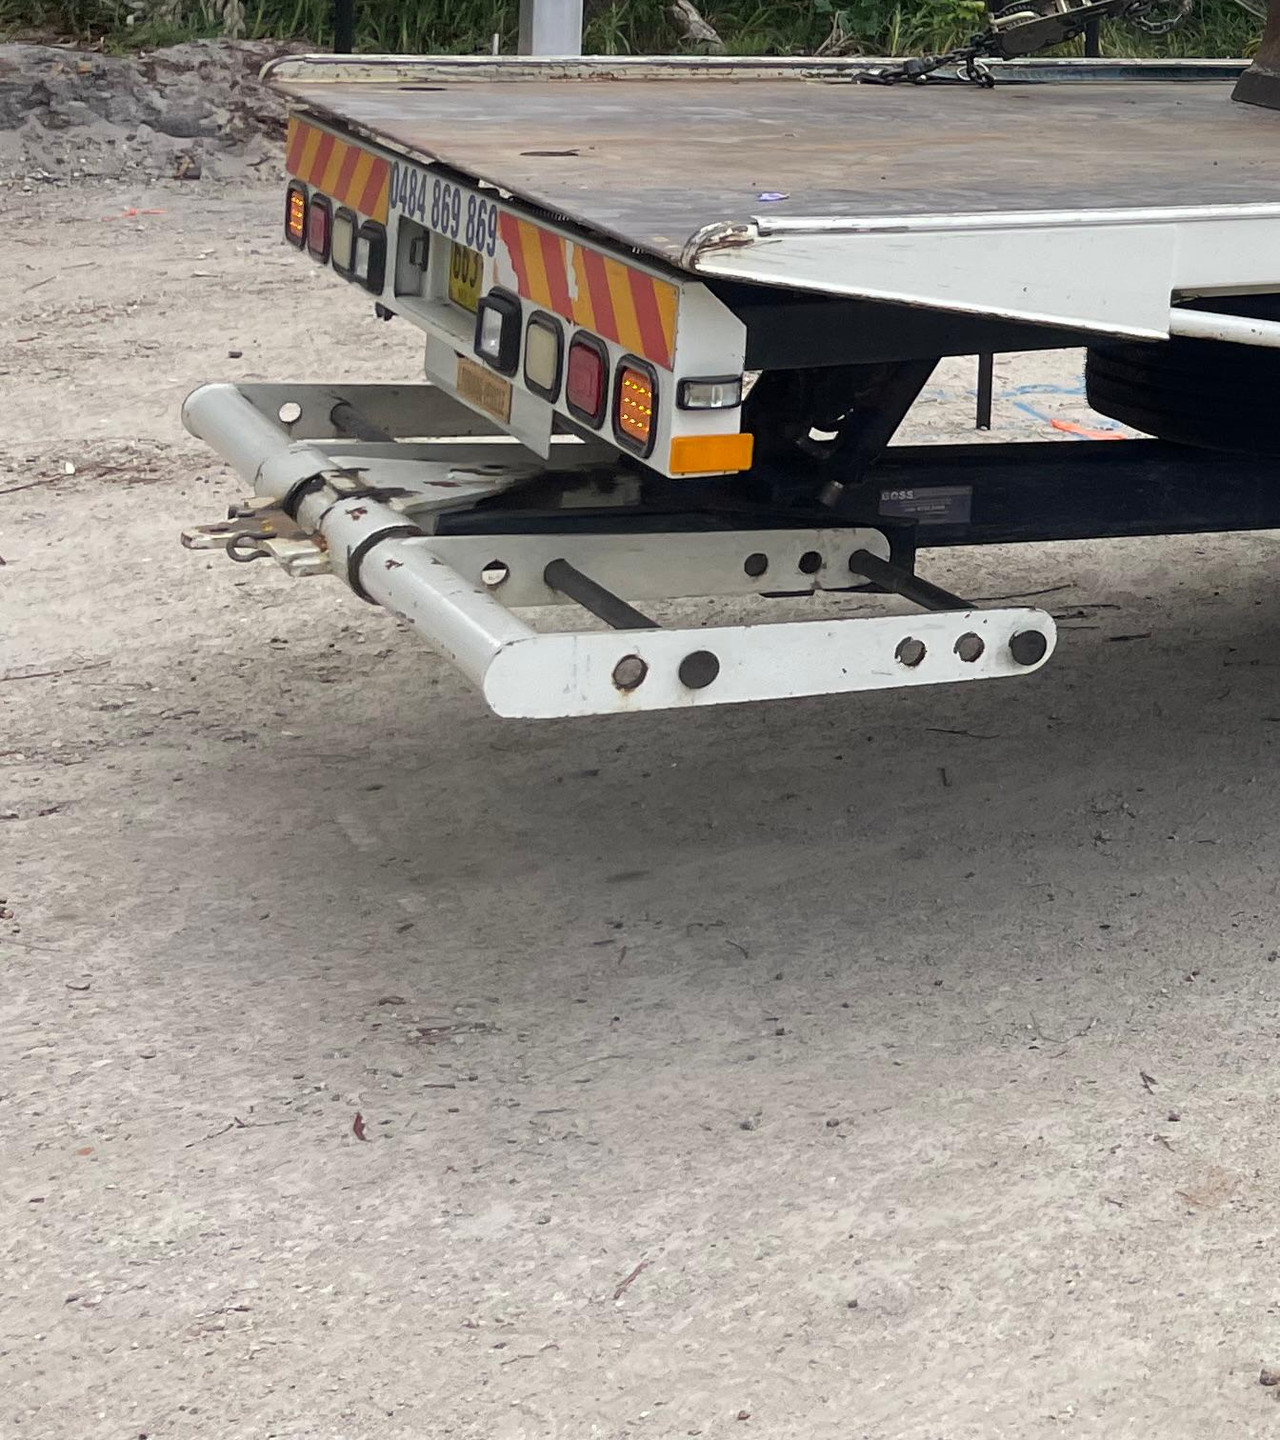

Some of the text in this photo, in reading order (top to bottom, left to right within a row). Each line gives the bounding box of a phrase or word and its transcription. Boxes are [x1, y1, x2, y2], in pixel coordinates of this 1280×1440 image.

[390, 161, 498, 258] 0484 869 869
